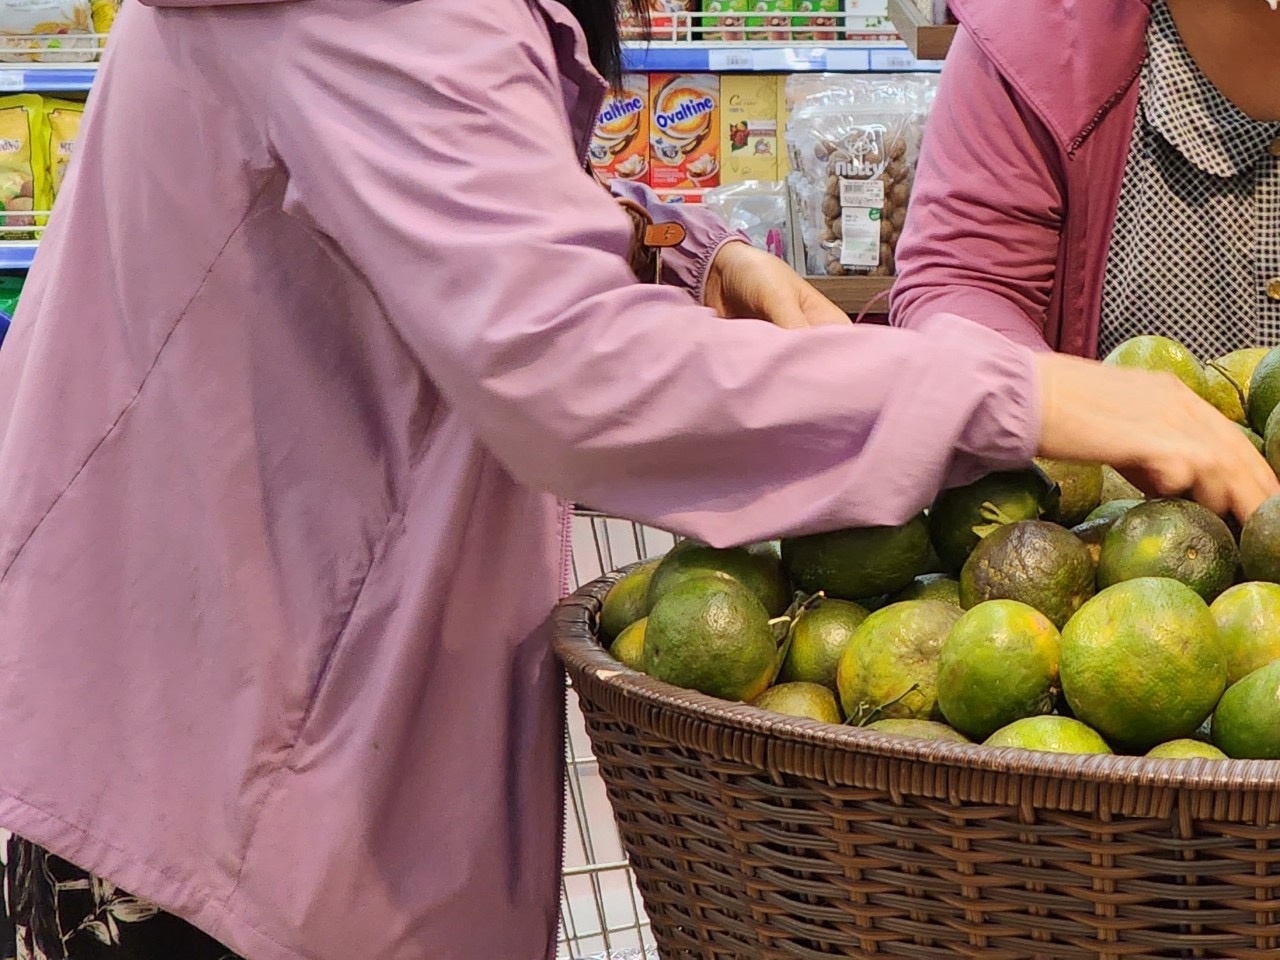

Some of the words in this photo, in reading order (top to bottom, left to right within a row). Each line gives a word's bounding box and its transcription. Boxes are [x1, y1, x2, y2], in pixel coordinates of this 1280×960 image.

[599, 97, 643, 124] valtine
[656, 97, 714, 129] Ovaltine
[835, 159, 886, 177] nutty
